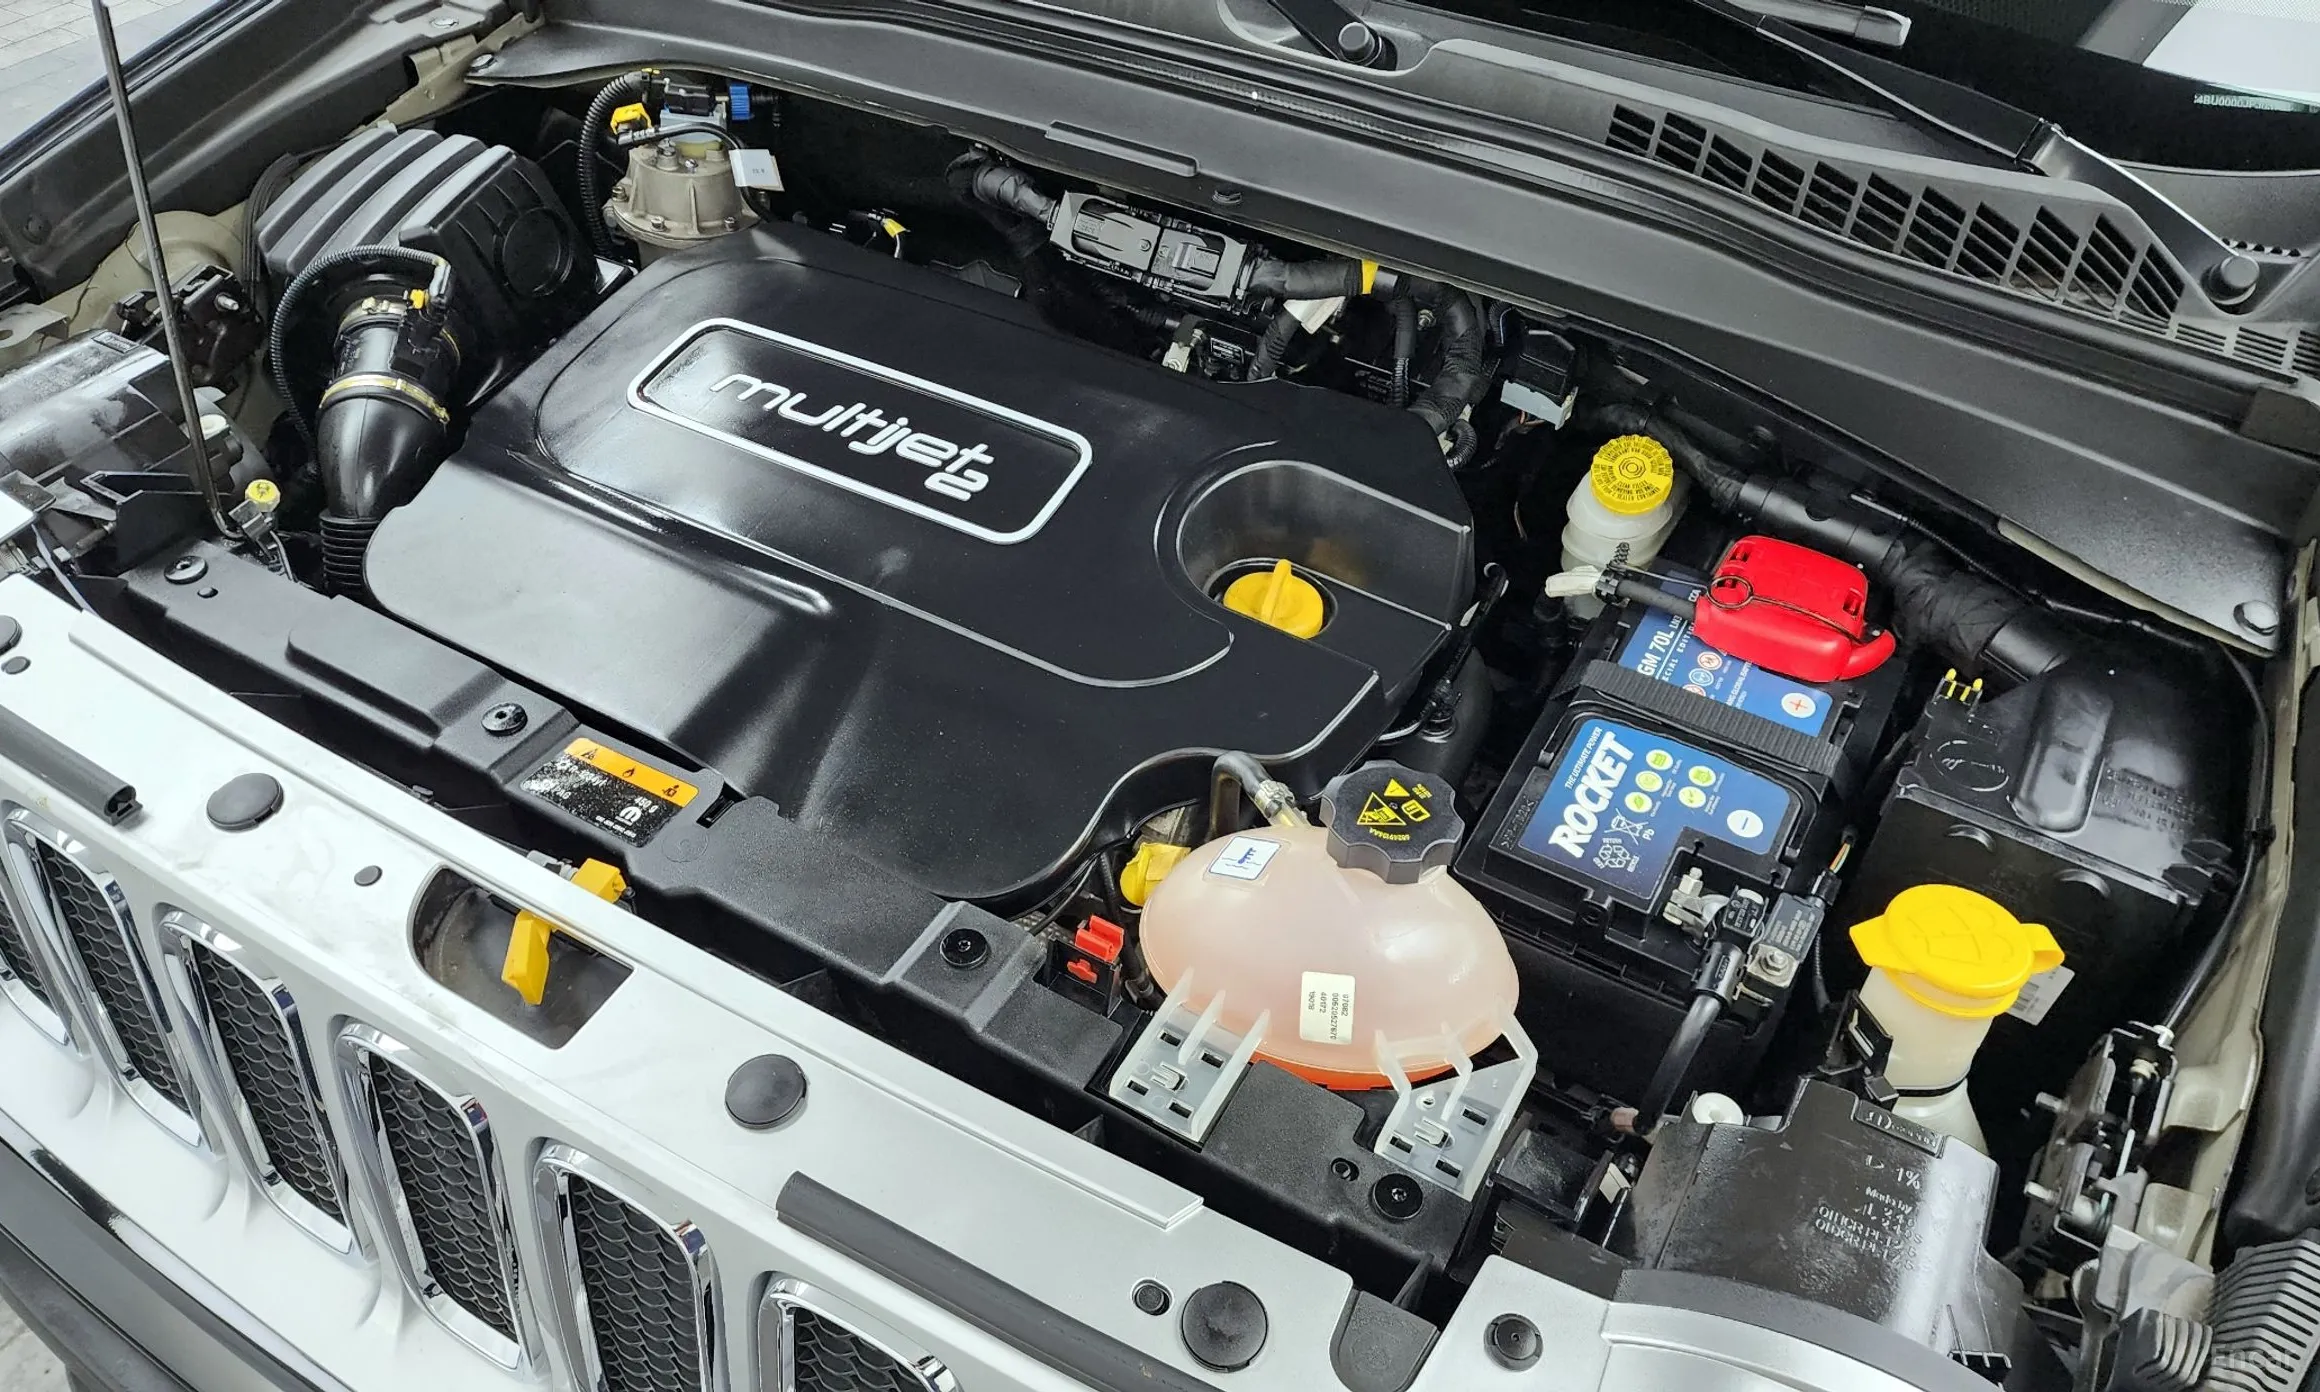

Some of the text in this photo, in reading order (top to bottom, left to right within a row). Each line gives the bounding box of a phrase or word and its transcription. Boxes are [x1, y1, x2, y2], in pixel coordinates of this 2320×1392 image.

[710, 374, 995, 474] multijet
[924, 468, 990, 502] 2
[1648, 630, 1675, 654] 70L
[1662, 622, 1695, 682] ECIAL EDITIO
[1637, 651, 1661, 676] GM
[1564, 726, 1603, 790] THE ULTIMATE POWER
[634, 796, 652, 809] 450
[1548, 731, 1635, 858] ROCKET
[1642, 828, 1655, 840] Pb
